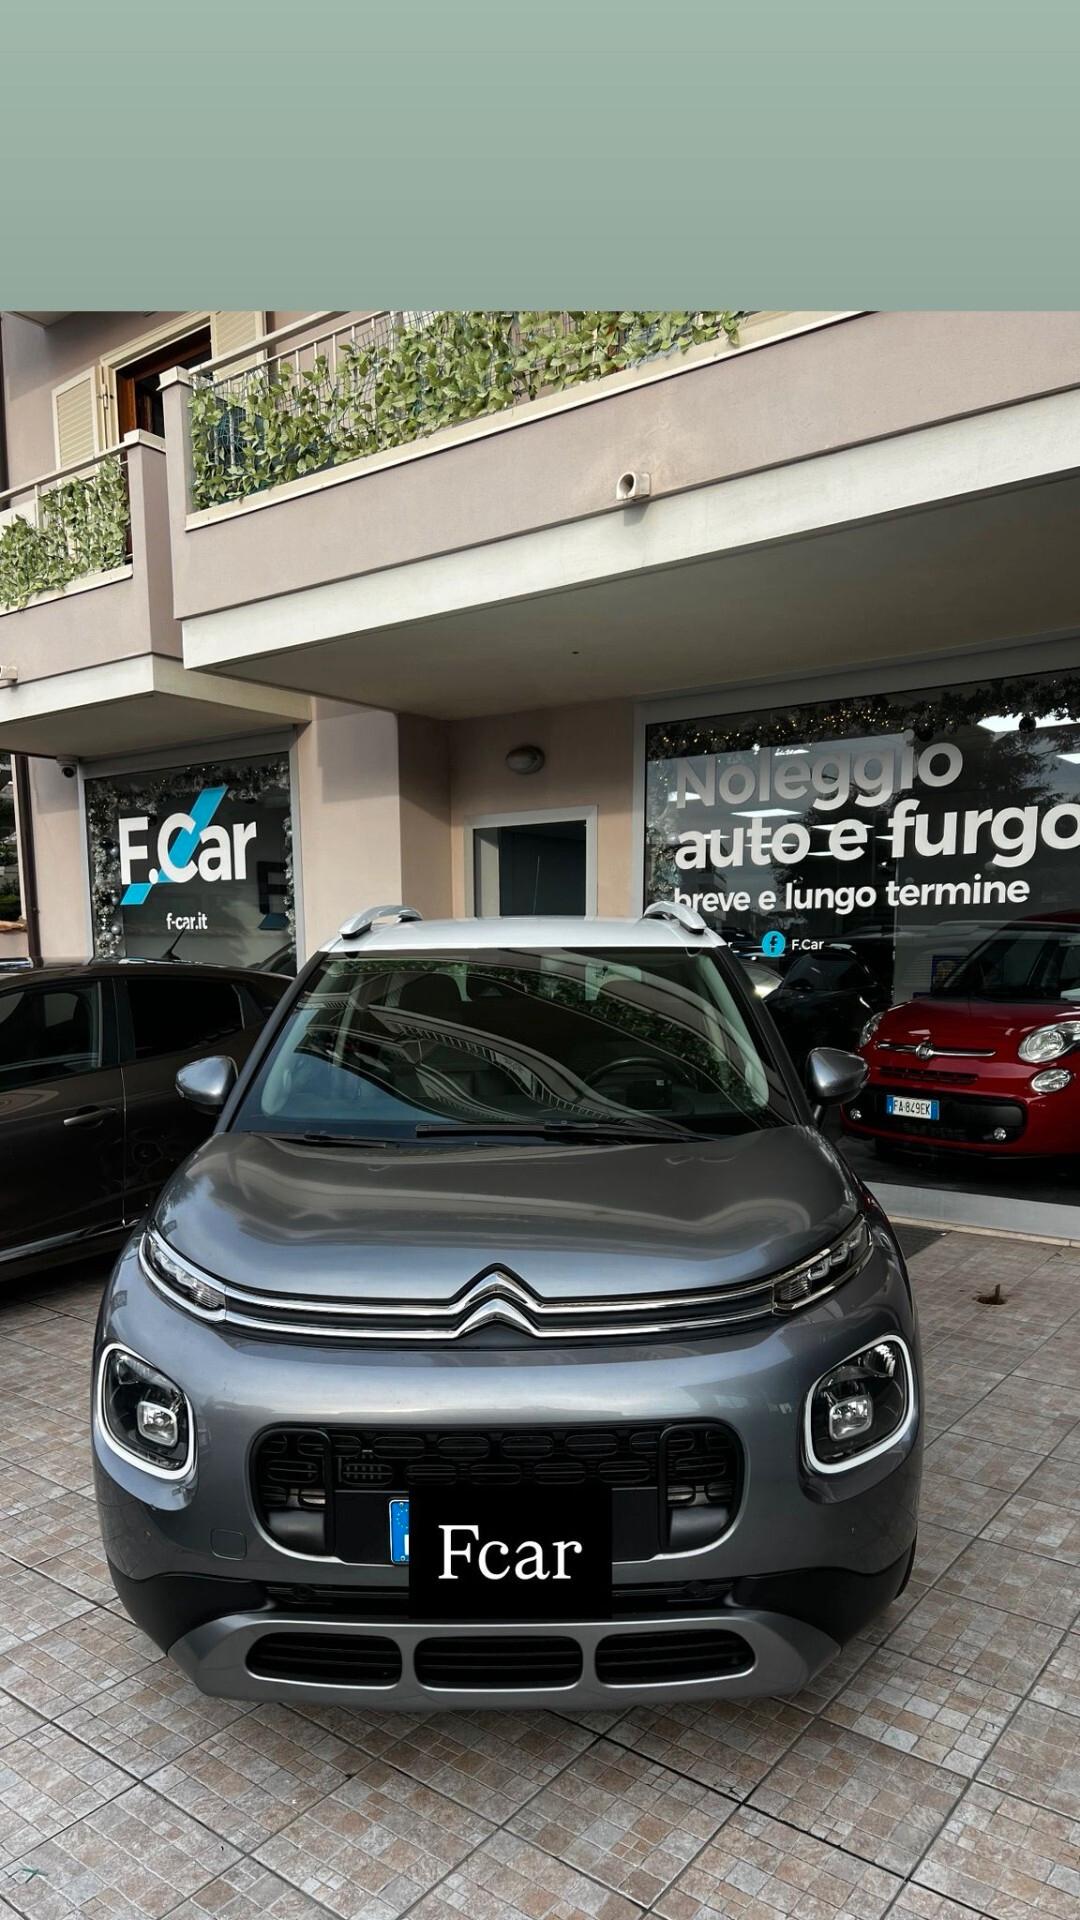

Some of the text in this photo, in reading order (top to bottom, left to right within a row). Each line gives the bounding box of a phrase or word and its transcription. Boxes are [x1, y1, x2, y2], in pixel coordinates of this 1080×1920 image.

[675, 729, 964, 812] Noleggio
[118, 812, 257, 885] F.Car
[674, 799, 1080, 870] auto e furgo
[166, 912, 208, 930] f-car.it
[674, 873, 1031, 916] breve e lungo termine
[791, 938, 825, 951] F.Car
